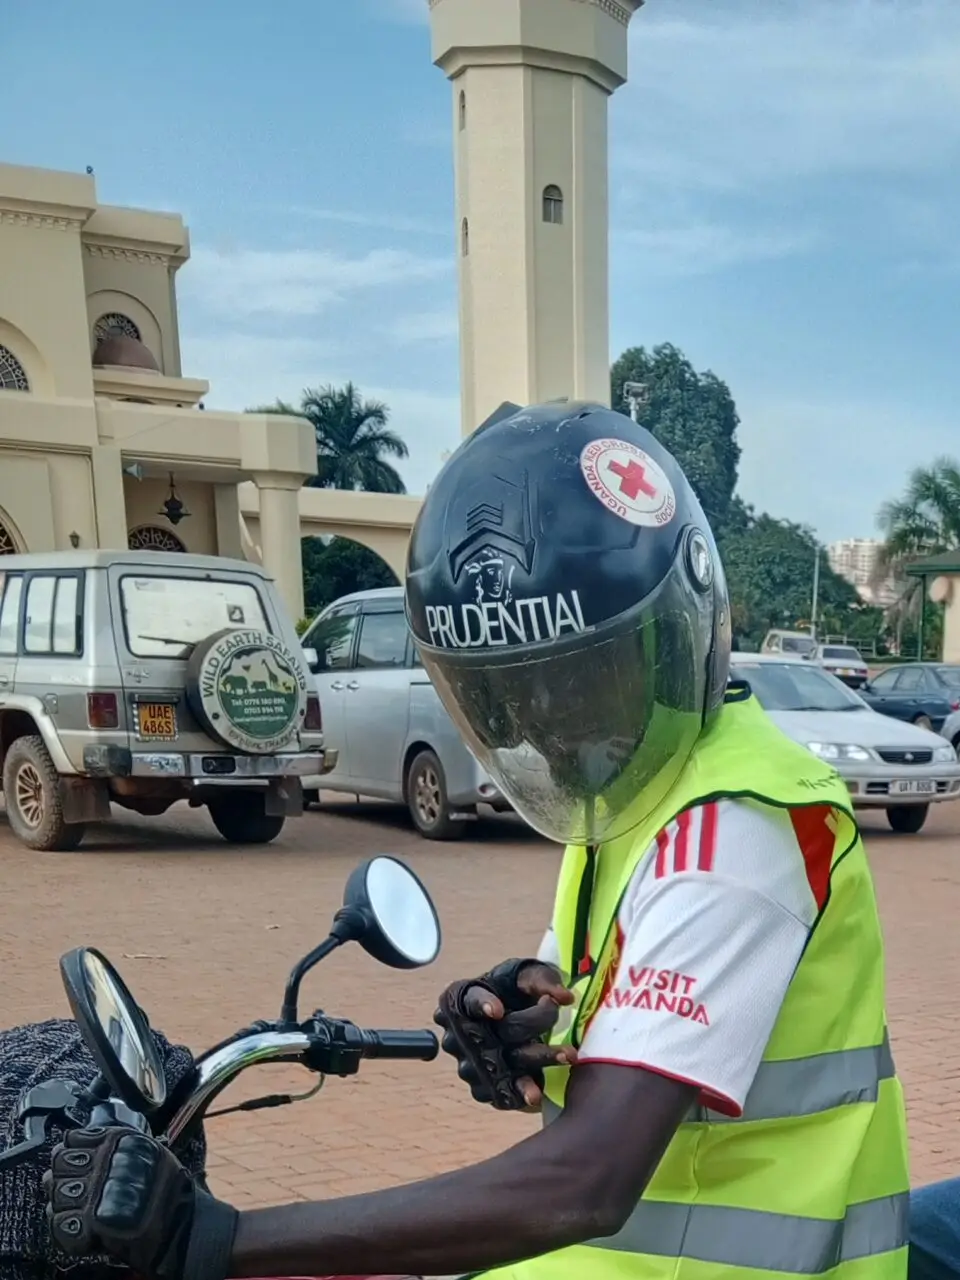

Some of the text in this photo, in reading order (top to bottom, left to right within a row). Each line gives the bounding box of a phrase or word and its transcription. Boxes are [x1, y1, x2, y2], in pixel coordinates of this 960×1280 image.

[584, 444, 602, 462] RED
[584, 464, 628, 517] UGANDA
[425, 590, 596, 648] PRUDENTIAL
[203, 657, 221, 698] WILD
[216, 632, 263, 658] EARTH
[148, 705, 172, 719] UAE
[143, 720, 172, 734] 486S
[628, 966, 697, 994] VISIT
